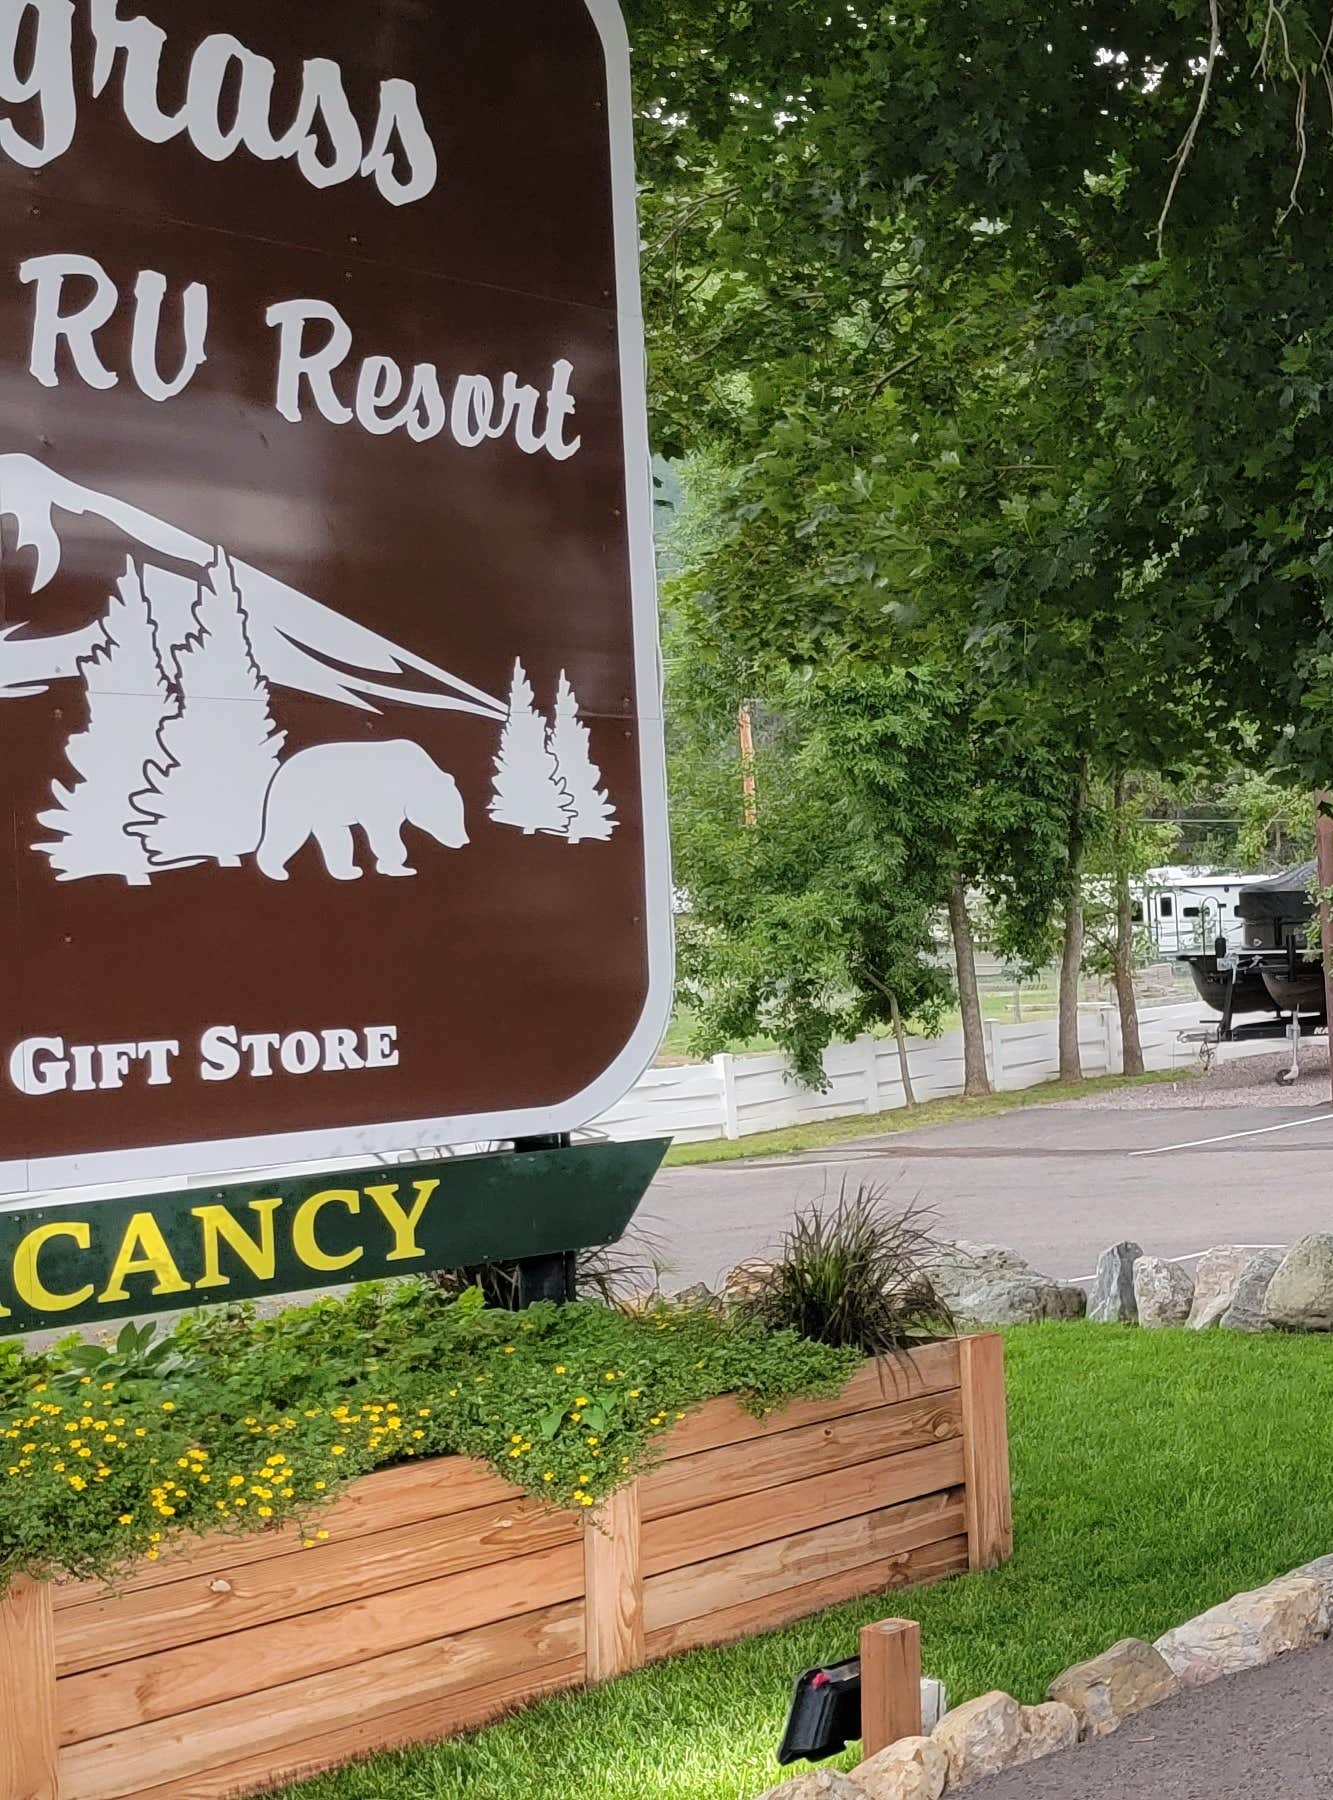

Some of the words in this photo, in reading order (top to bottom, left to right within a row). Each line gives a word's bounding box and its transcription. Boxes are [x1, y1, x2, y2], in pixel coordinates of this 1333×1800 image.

[20, 254, 208, 401] RV
[266, 299, 580, 460] Resort
[10, 1037, 179, 1096] GIFT
[201, 1026, 399, 1081] STORE
[0, 1180, 440, 1318] CANCY
